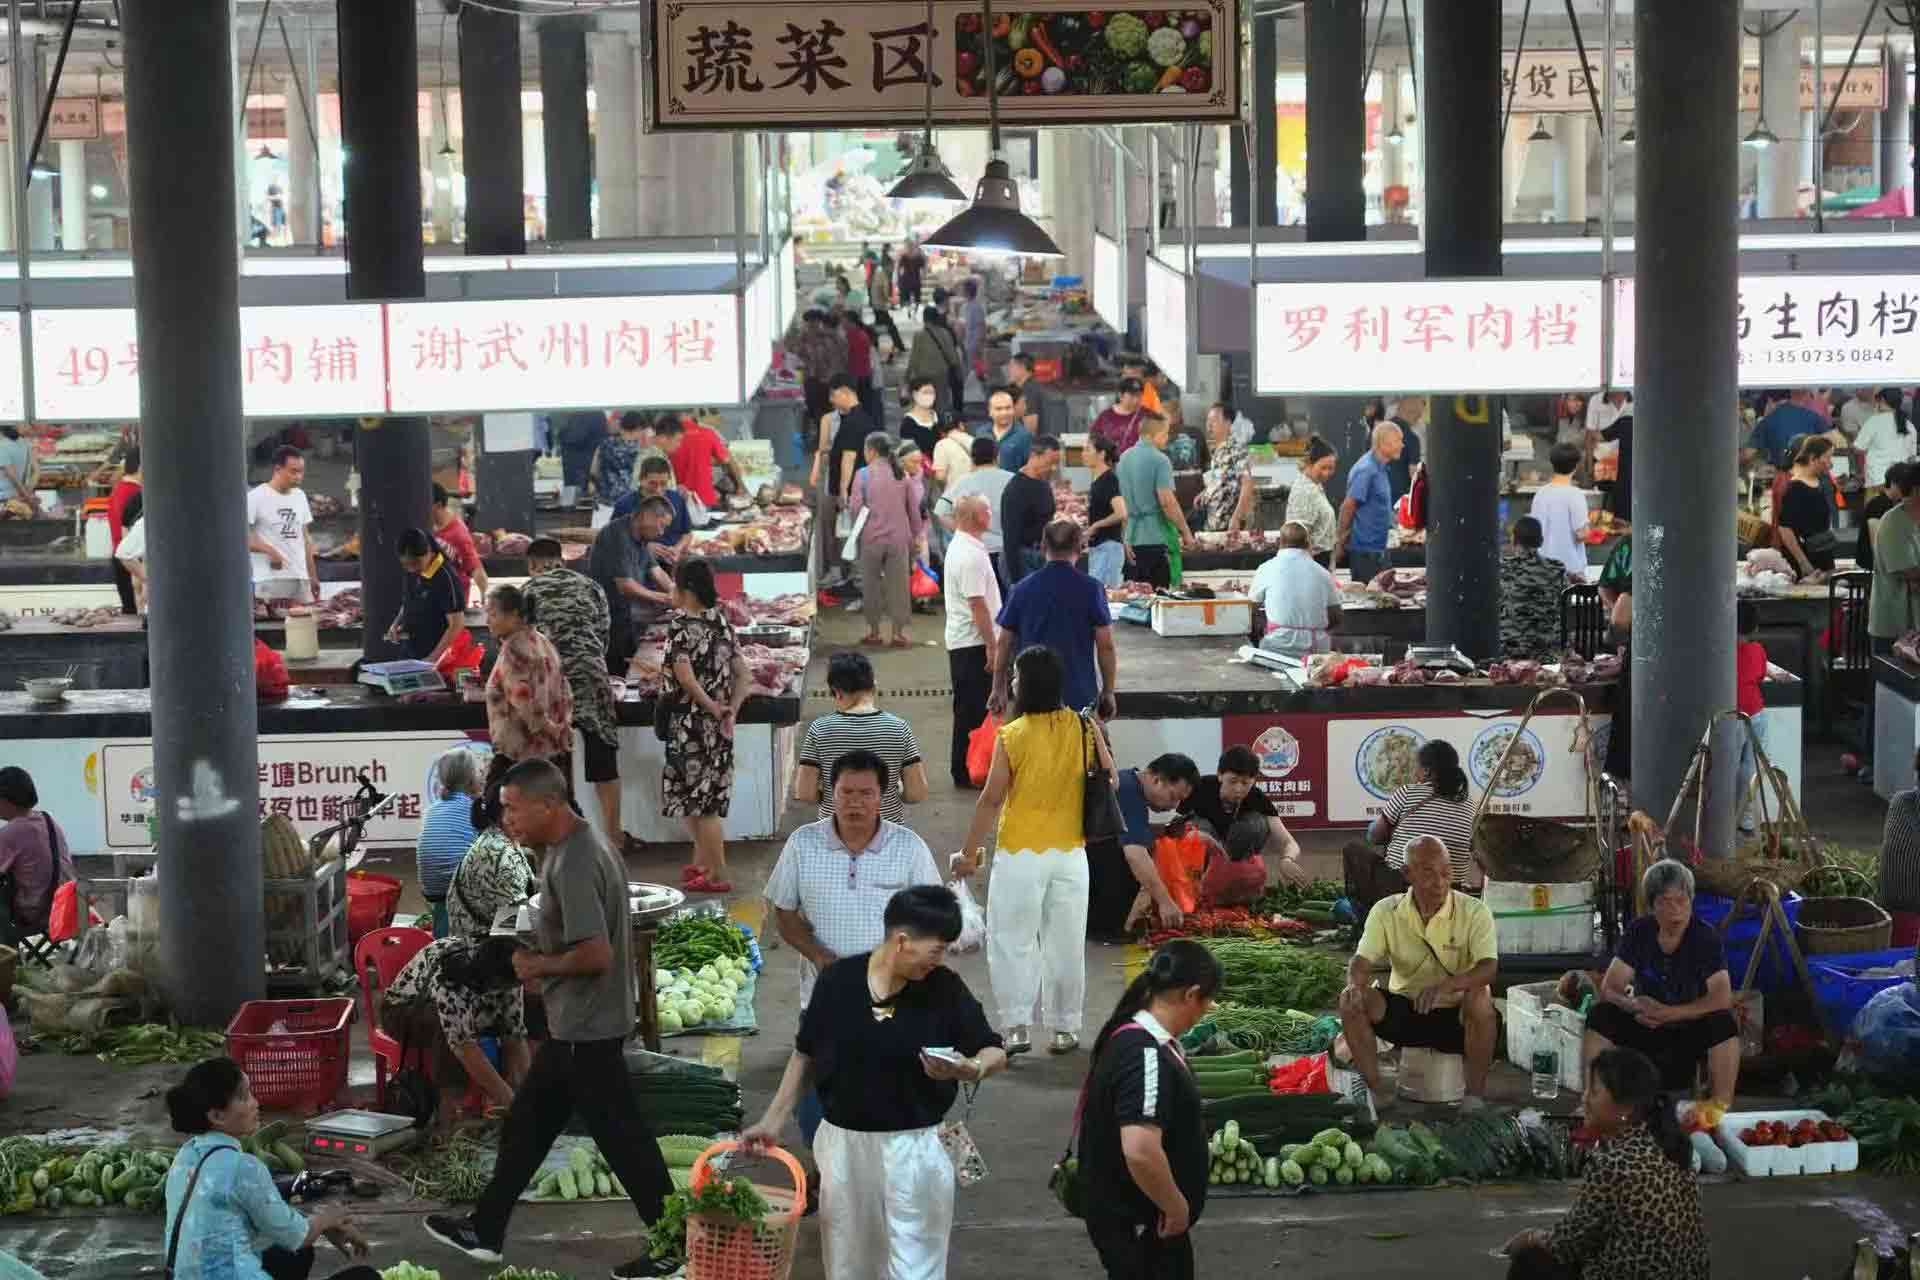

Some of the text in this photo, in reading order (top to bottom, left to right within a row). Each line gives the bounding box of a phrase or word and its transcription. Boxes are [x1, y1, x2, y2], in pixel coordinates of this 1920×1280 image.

[682, 19, 943, 95] 蔬菜区
[411, 319, 717, 371] 谢武州肉档
[1283, 302, 1579, 352] 罗利军肉档
